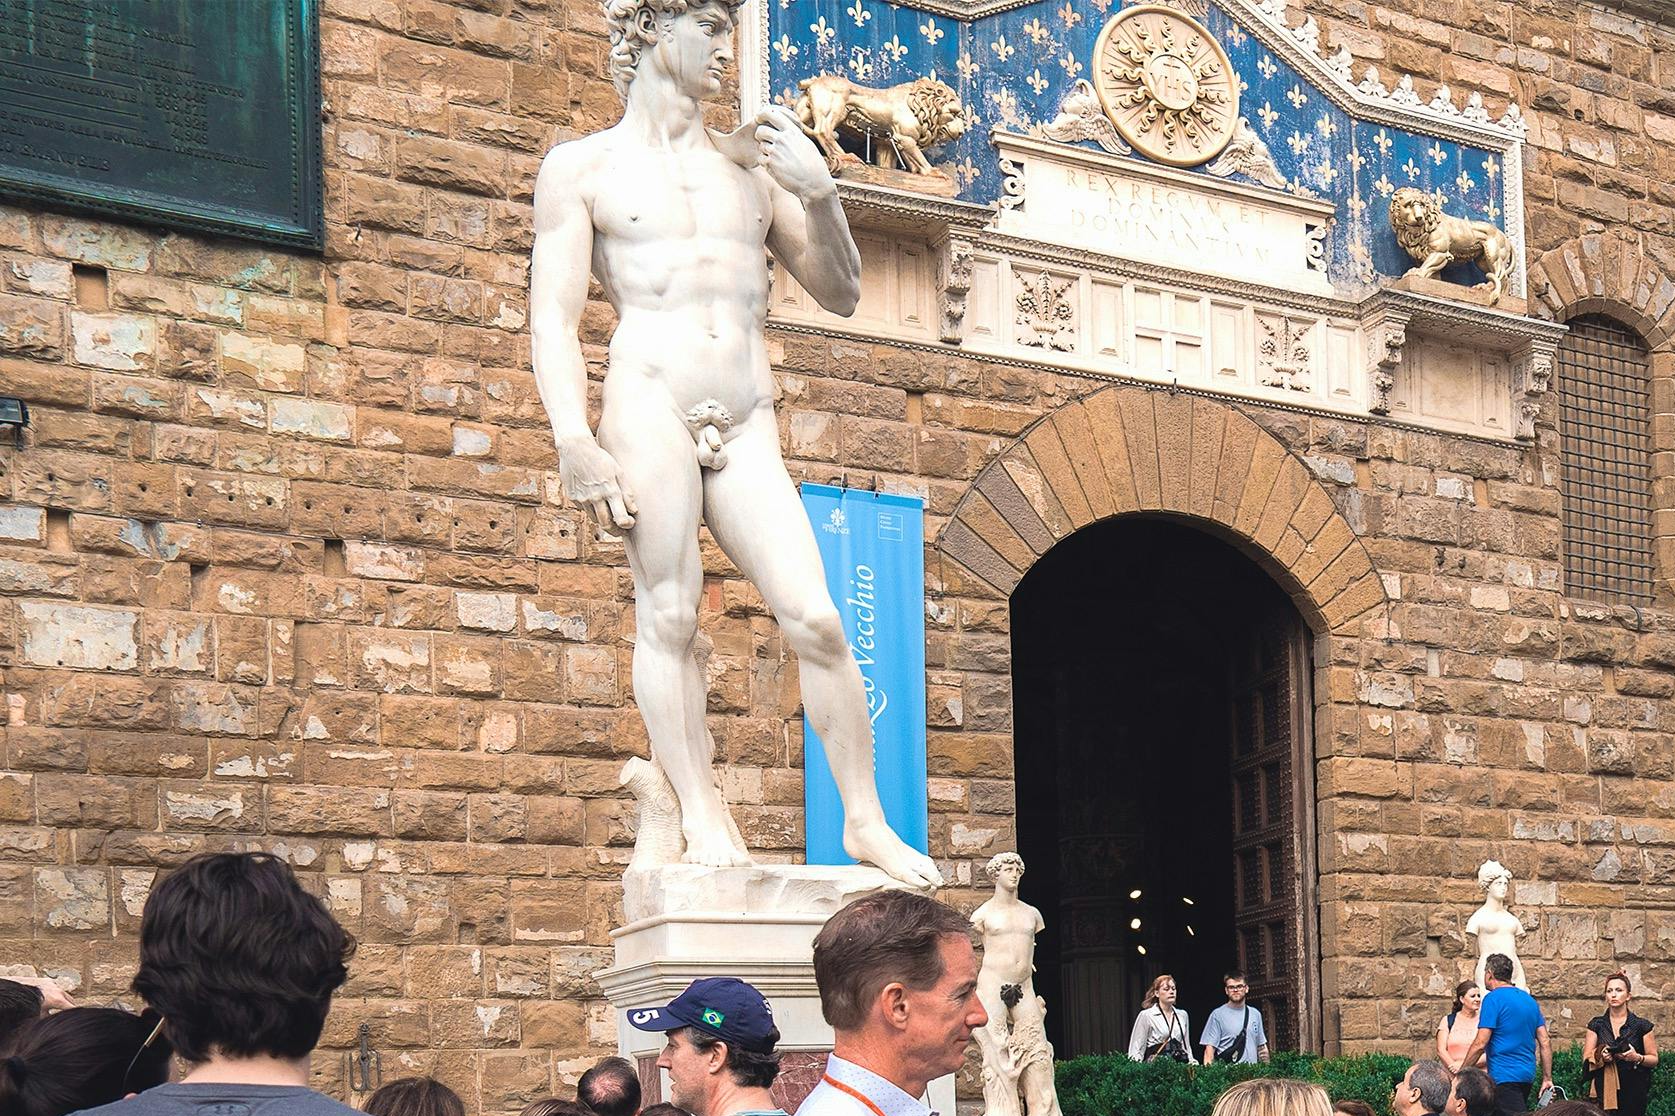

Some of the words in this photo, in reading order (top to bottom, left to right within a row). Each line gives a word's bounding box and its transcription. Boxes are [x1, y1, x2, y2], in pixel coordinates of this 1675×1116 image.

[1065, 169, 1118, 197] REX
[1240, 205, 1271, 226] ET
[847, 564, 875, 665] Vecchio
[633, 1009, 660, 1024] 5
